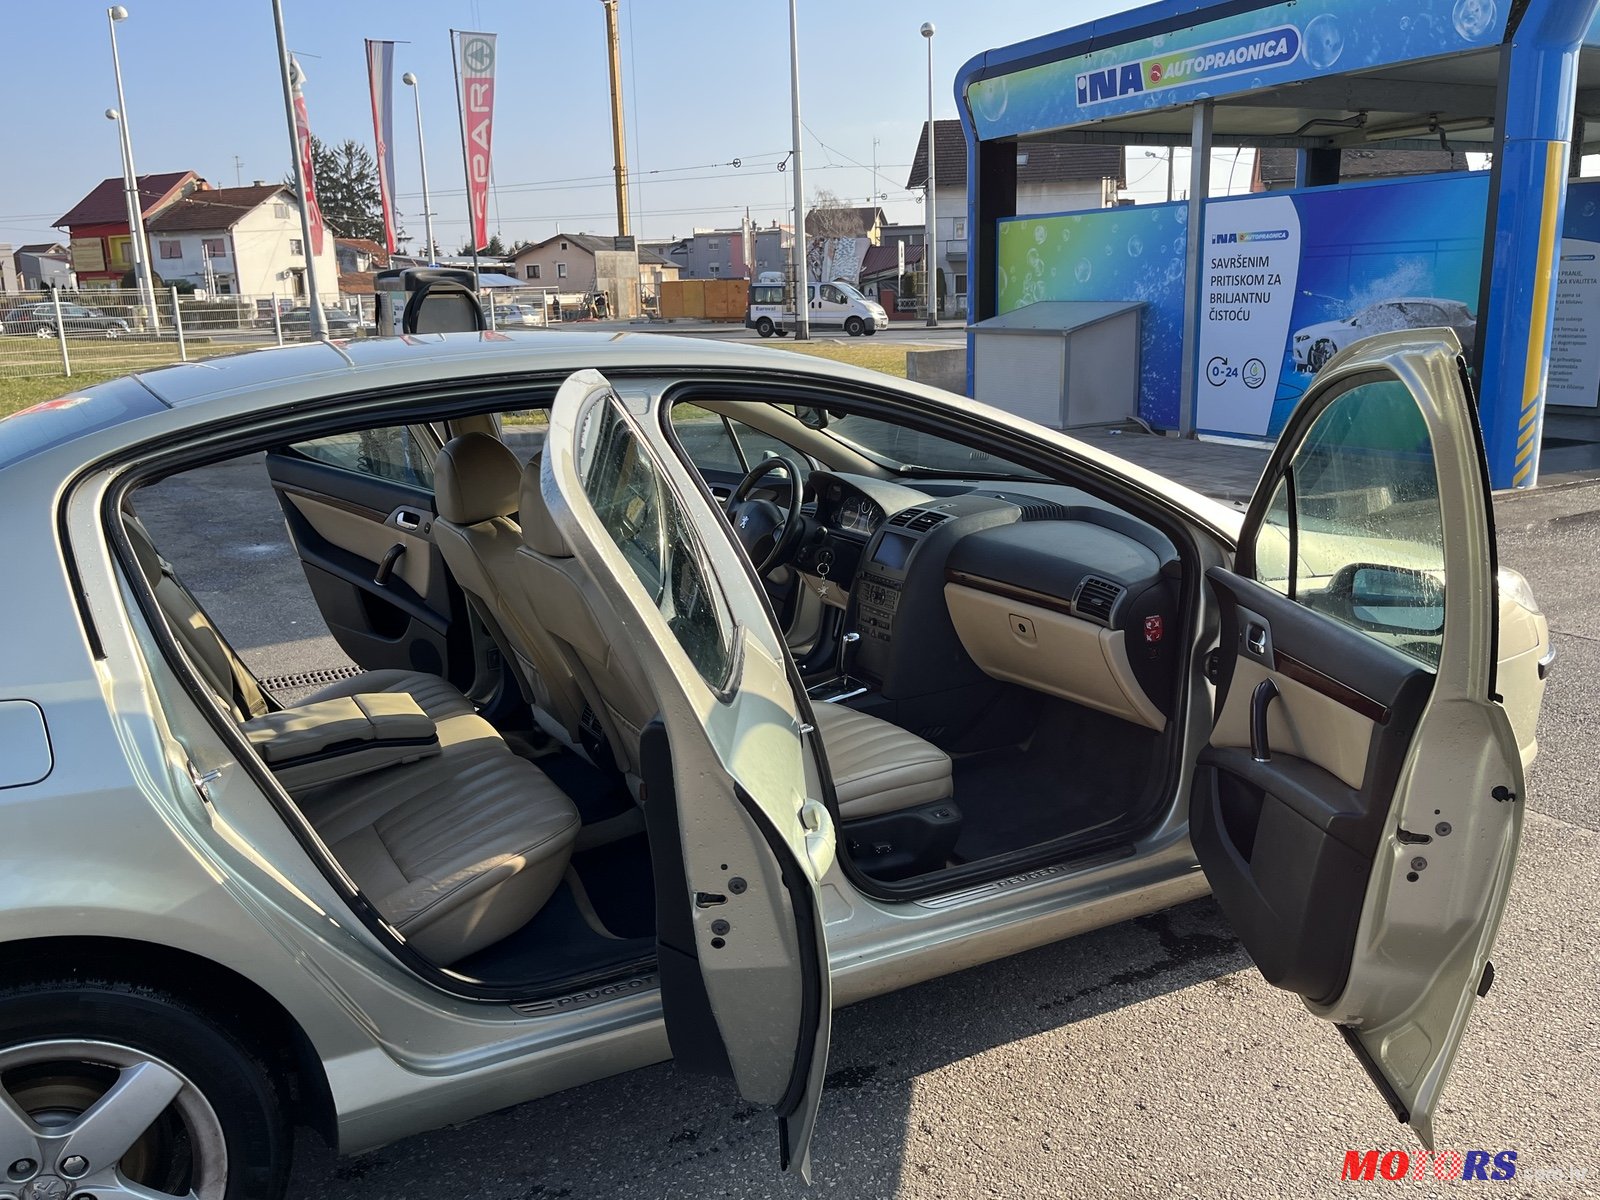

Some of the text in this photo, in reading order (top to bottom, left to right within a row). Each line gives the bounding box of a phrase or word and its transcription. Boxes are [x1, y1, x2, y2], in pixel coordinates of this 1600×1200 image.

[1163, 37, 1288, 79] AUTOPRAONICA
[1210, 254, 1270, 270] SAVRŠENIM
[1210, 273, 1282, 287] PRITISKOM ZA
[1209, 292, 1271, 304] BRILJANTNU
[1209, 307, 1250, 321] ČISTOĆU
[1212, 366, 1238, 378] 0-24
[998, 863, 1070, 888] PEUGEOT
[557, 975, 655, 1007] PEUGEOT
